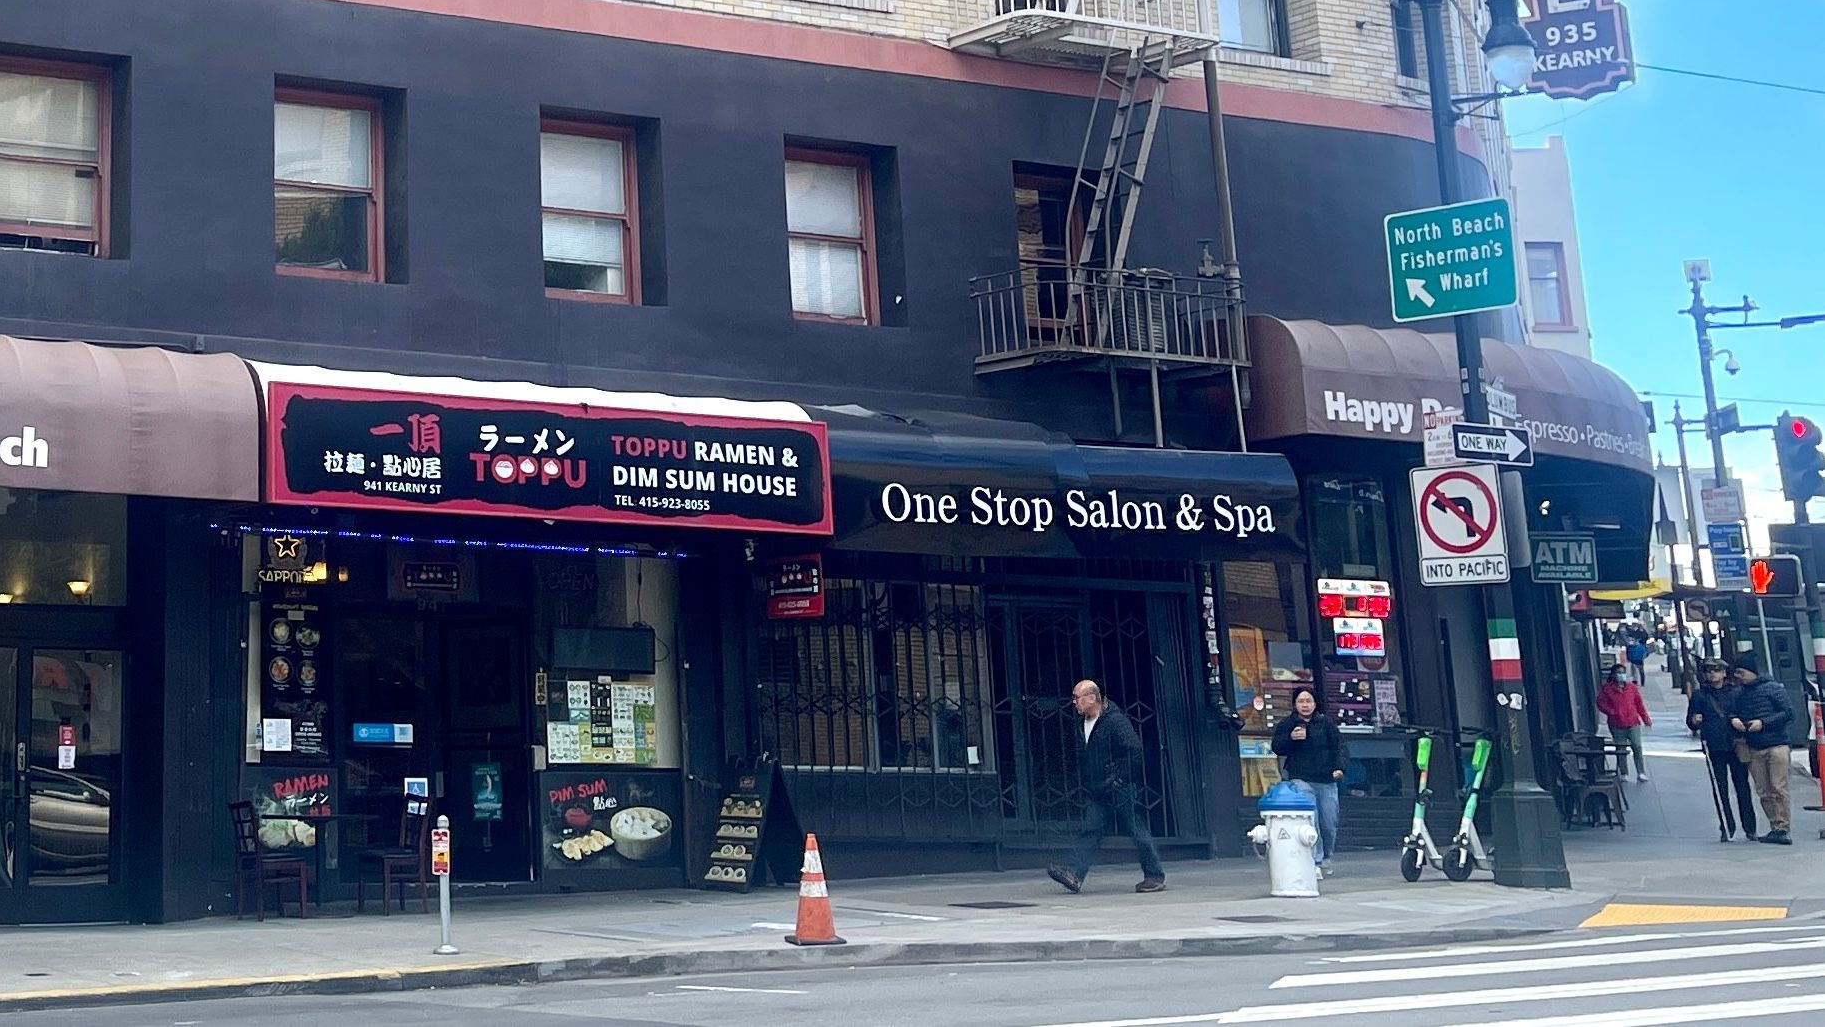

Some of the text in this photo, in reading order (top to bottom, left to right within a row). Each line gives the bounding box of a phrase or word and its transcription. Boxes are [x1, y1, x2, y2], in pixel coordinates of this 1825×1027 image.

[1545, 21, 1598, 47] 935
[1533, 45, 1615, 73] KEARNY
[1394, 212, 1505, 245] North Beach
[1400, 239, 1503, 271] Fisherman's
[1440, 267, 1488, 292] Wharf
[1324, 390, 1414, 434] Happy
[1424, 414, 1436, 428] NO
[370, 413, 441, 453] 一頂
[479, 424, 575, 456] ラーメン
[1461, 435, 1483, 450] ONE
[1486, 438, 1507, 452] WAY
[611, 435, 799, 468] TOPPU RAMEN &
[469, 453, 586, 489] TOPPU
[612, 465, 798, 497] DIM SUM HOUSE
[363, 480, 442, 495] 941 KEARNY ST
[639, 496, 711, 511] 415-923-8055
[881, 482, 1276, 538] One Stop Salon & Spa
[1535, 541, 1592, 564] ATM
[1426, 559, 1504, 579] INTO PACIFIC
[273, 774, 329, 798] RAMEN
[549, 778, 608, 805] DIM SUM
[285, 793, 329, 808] ラーメン
